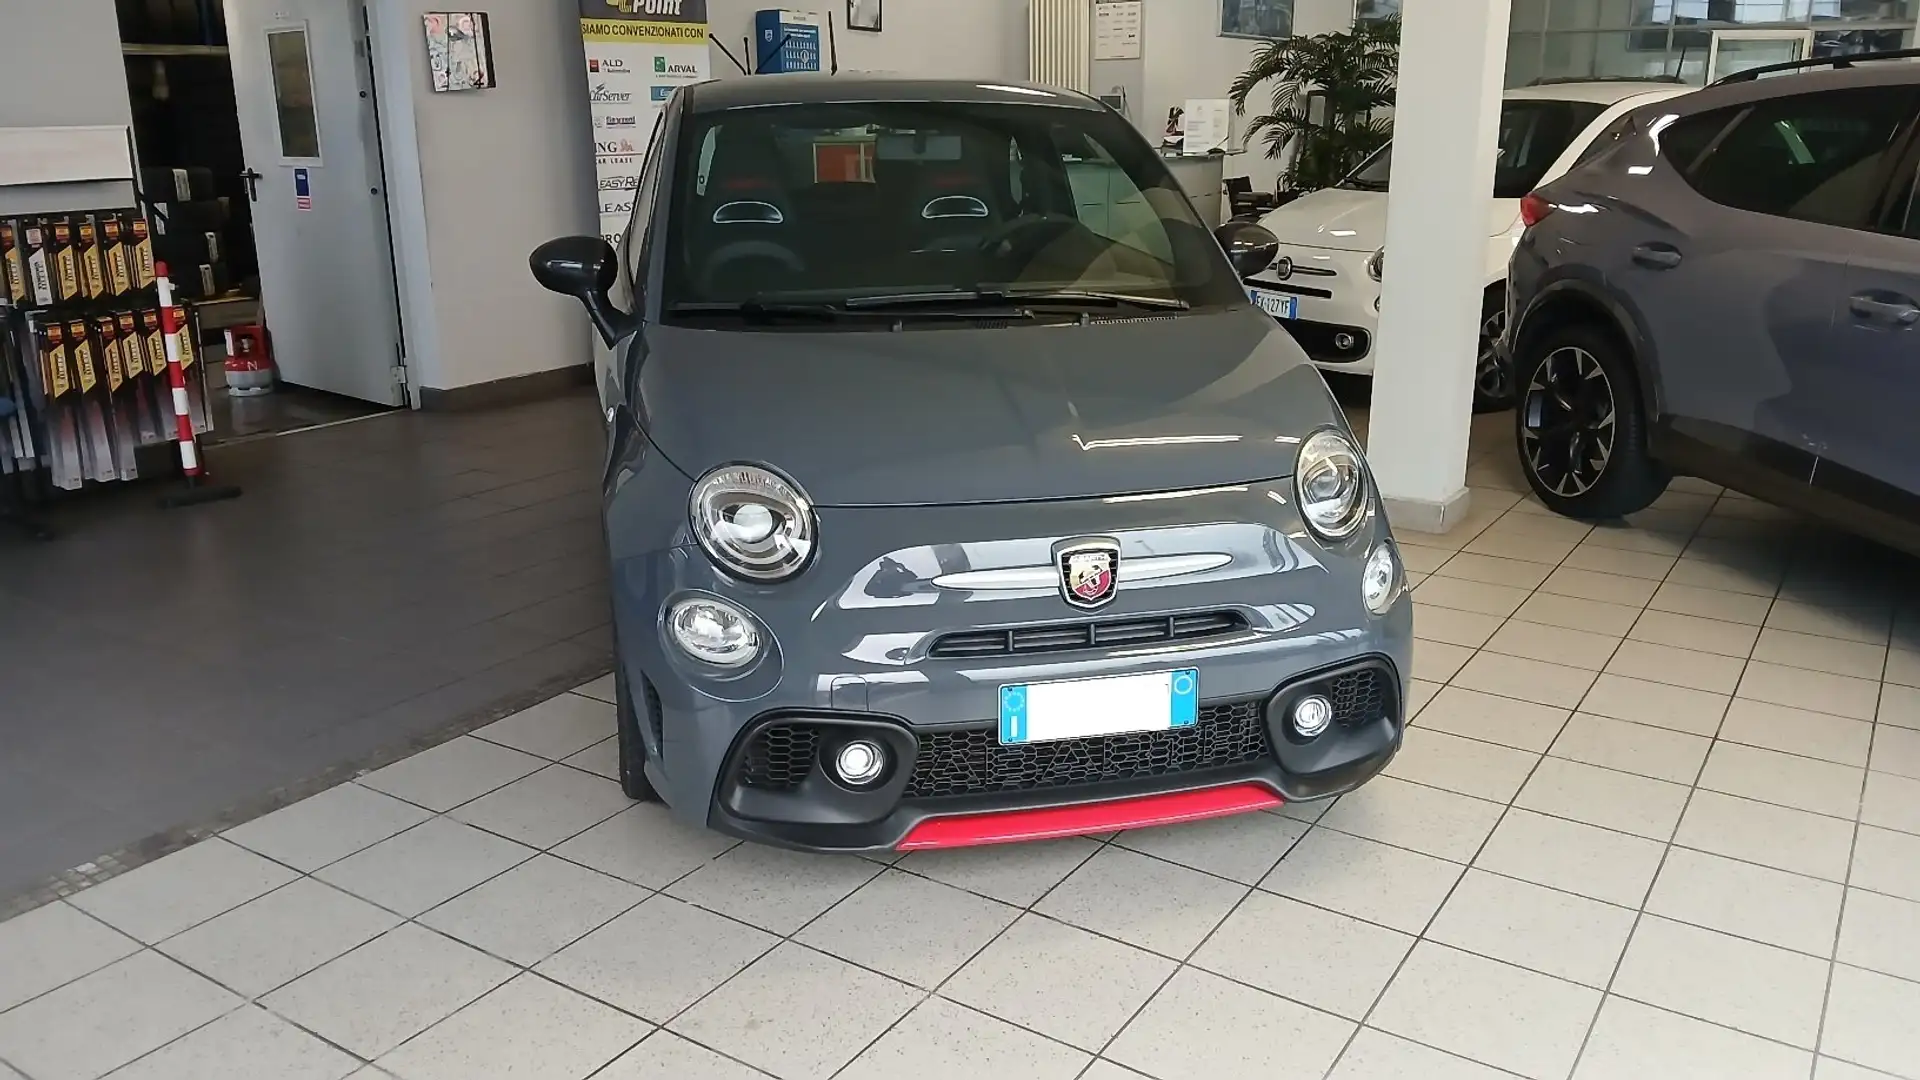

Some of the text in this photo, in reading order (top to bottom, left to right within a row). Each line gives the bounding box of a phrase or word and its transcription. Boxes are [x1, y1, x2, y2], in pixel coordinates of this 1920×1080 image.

[582, 23, 704, 39] SIAMO CONVENZIONATI CON
[602, 59, 623, 67] ALD
[667, 65, 698, 73] ARVAL
